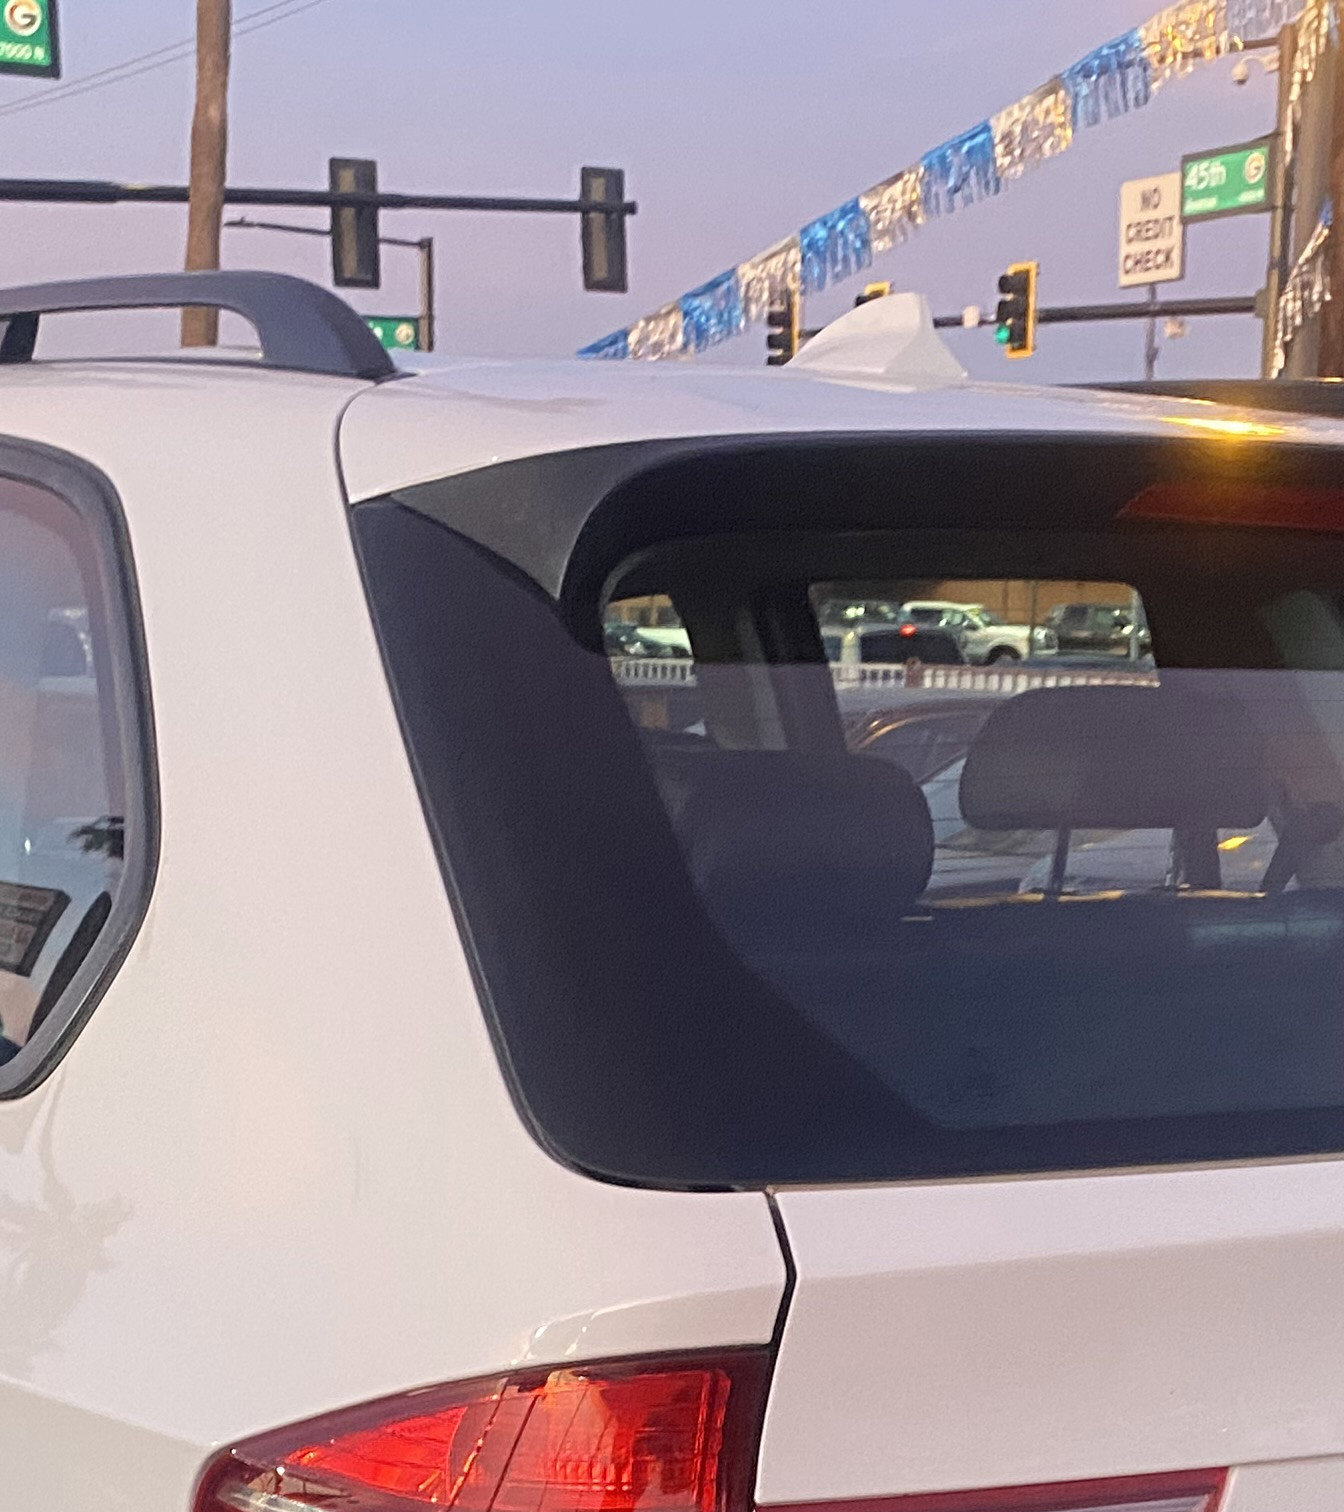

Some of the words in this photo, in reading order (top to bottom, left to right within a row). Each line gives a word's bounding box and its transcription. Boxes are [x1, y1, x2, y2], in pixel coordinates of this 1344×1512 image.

[1140, 186, 1161, 213] NO
[1126, 215, 1175, 244] CREDIT
[1123, 246, 1175, 275] CHECK
